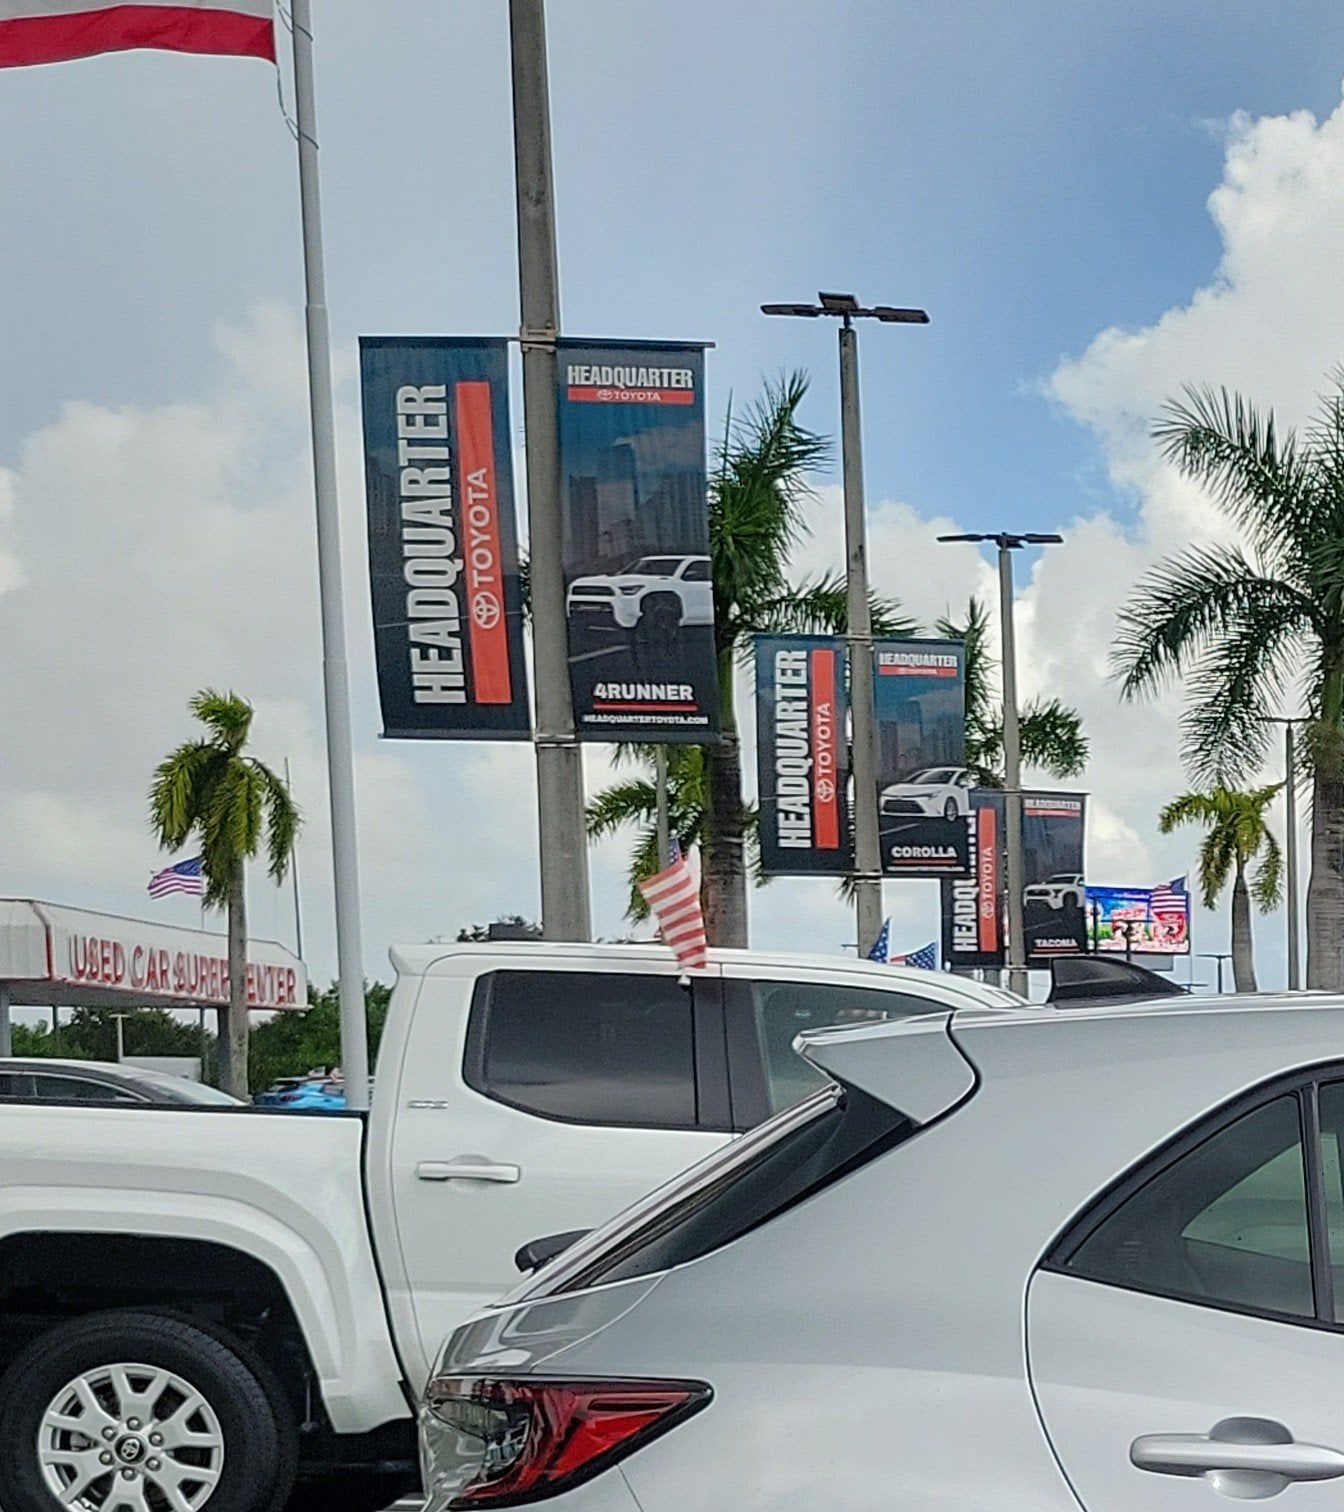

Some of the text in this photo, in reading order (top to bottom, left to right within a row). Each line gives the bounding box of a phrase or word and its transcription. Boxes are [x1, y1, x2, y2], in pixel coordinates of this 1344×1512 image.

[567, 365, 693, 389] HEADQUARTER
[615, 391, 661, 401] TOYOTA
[396, 384, 468, 705] HEADQUARTER
[467, 467, 495, 588] TOYOTA
[593, 683, 694, 700] 4RUNNER
[775, 650, 812, 849] HEADQUARTER
[815, 702, 833, 774] TOYOTA
[891, 846, 958, 858] COROLLA
[983, 847, 993, 893] TOYOTA
[69, 934, 297, 1005] USED CAR SUPERENTER
